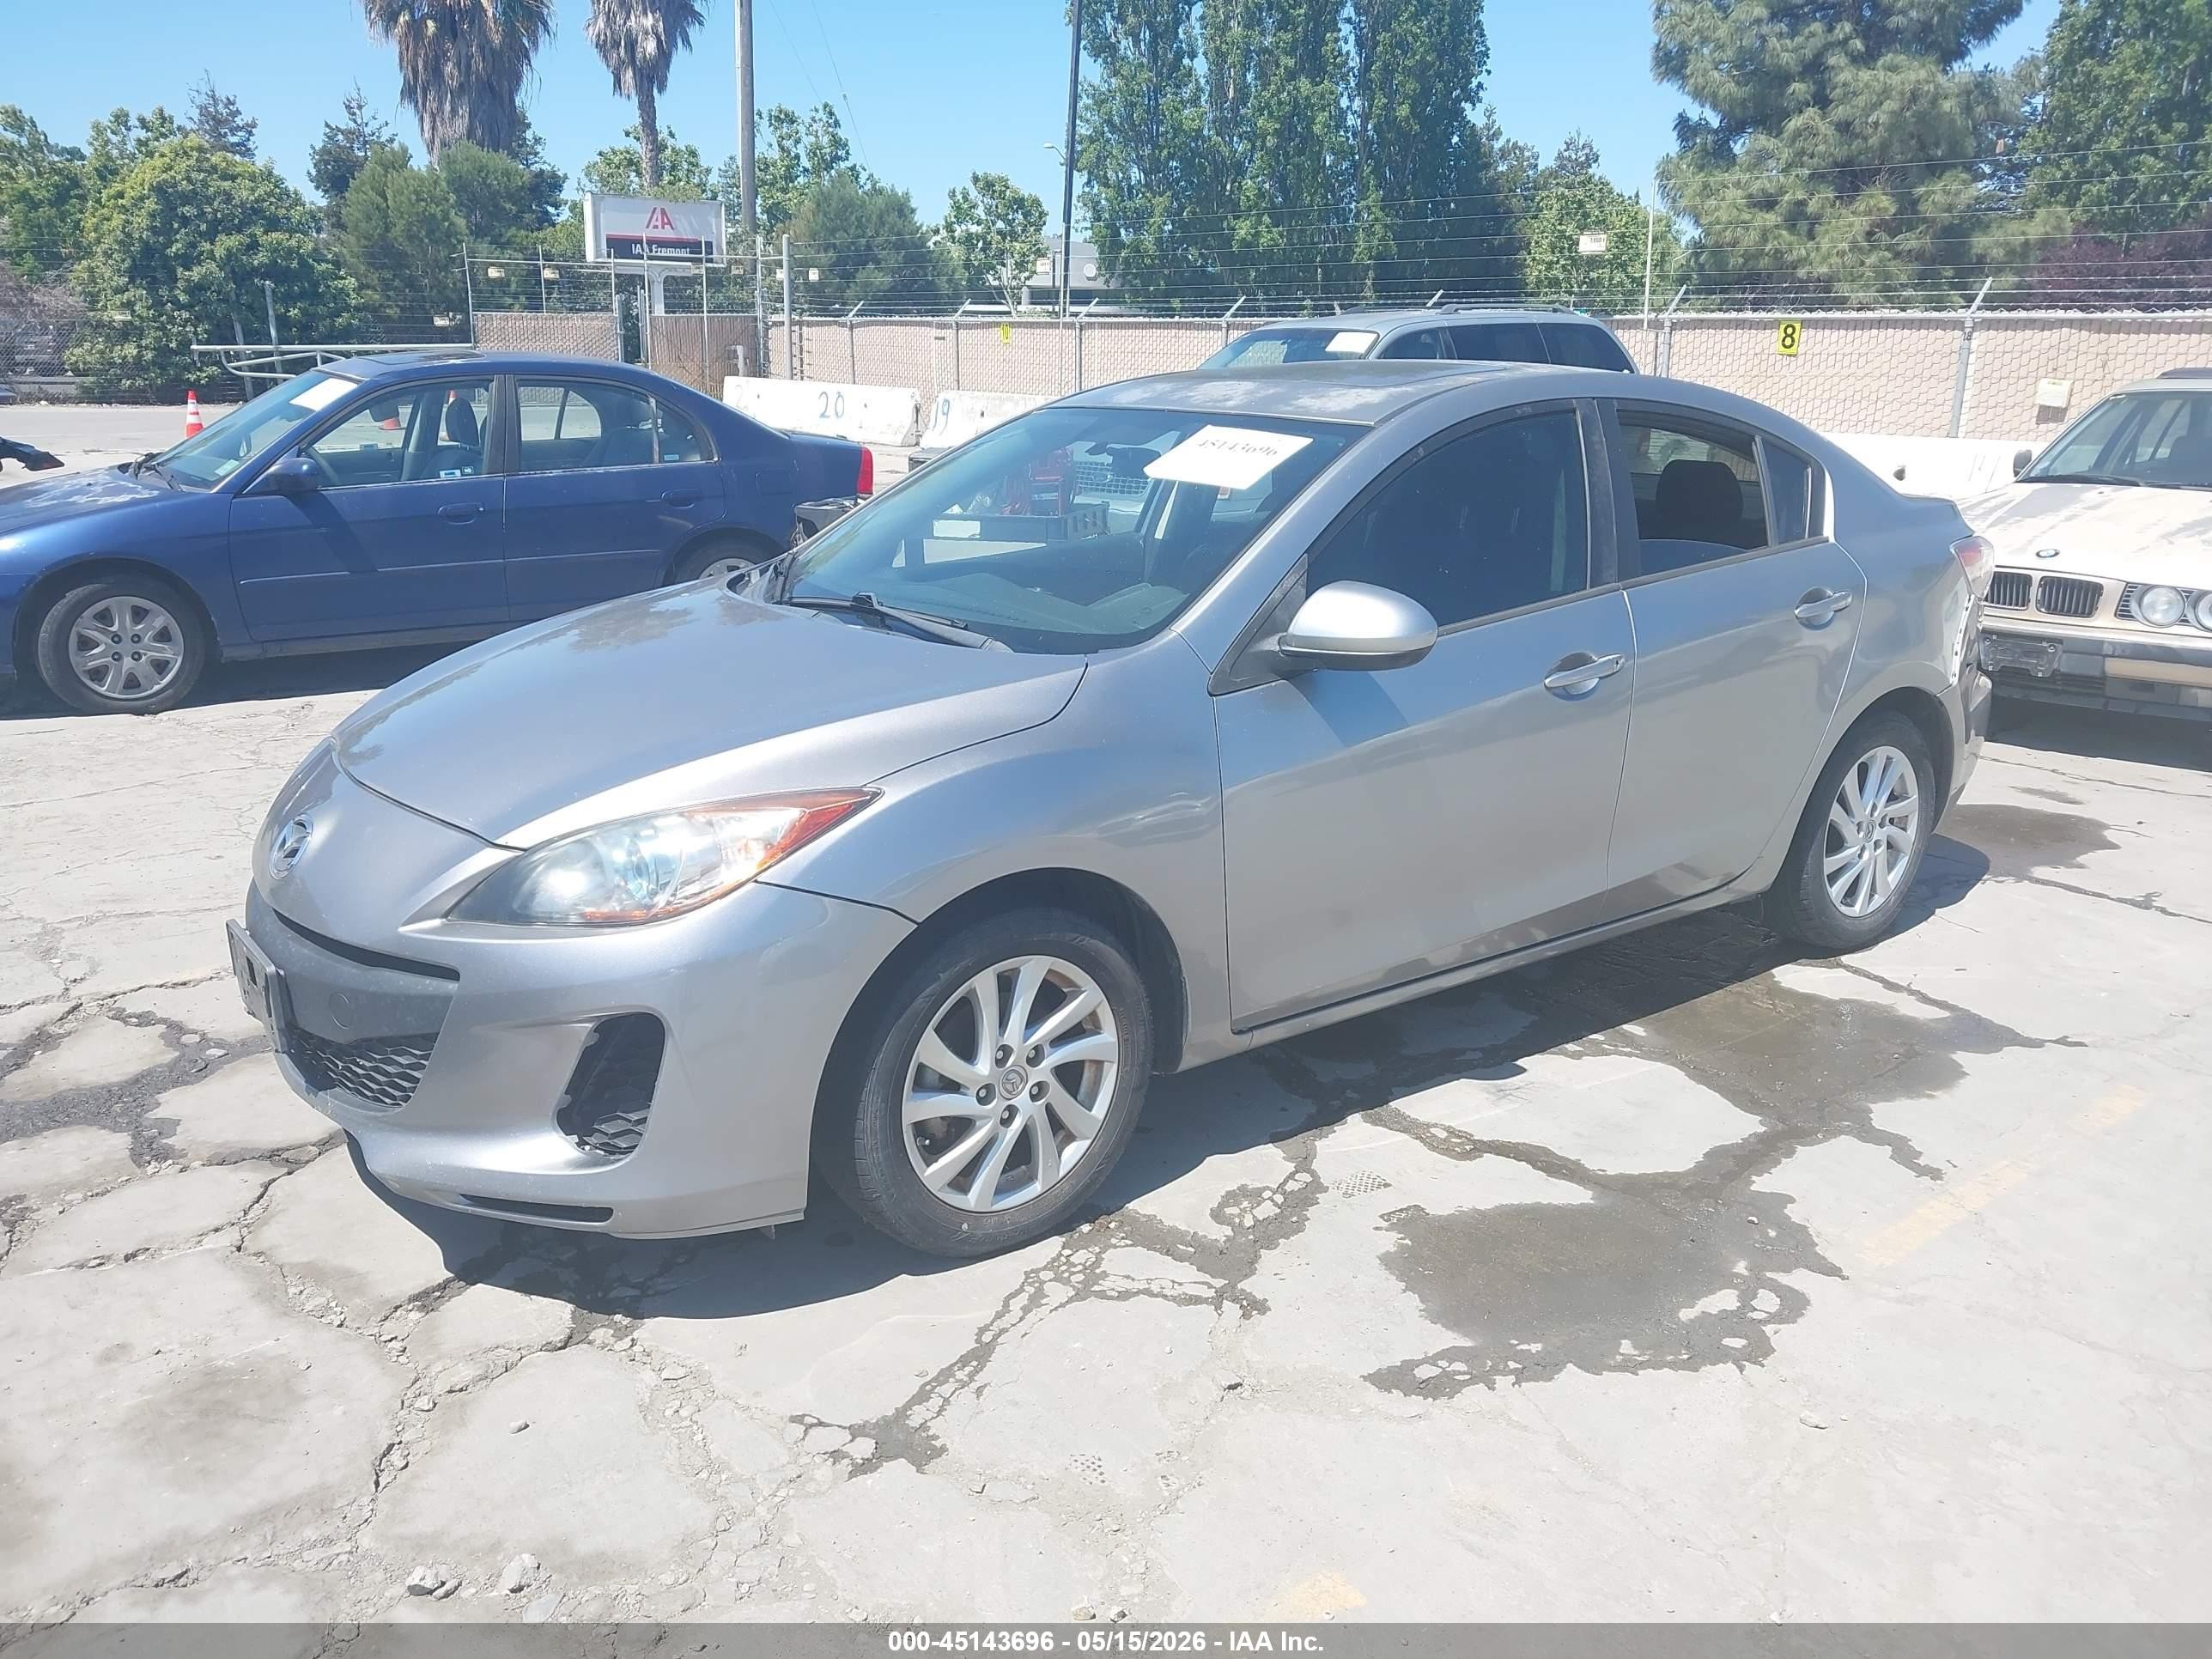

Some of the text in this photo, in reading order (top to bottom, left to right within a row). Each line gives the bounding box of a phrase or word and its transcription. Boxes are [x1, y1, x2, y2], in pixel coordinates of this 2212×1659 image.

[652, 245, 690, 256] Fremont
[1781, 323, 1796, 349] 8
[818, 391, 845, 419] 20
[932, 398, 951, 435] 19
